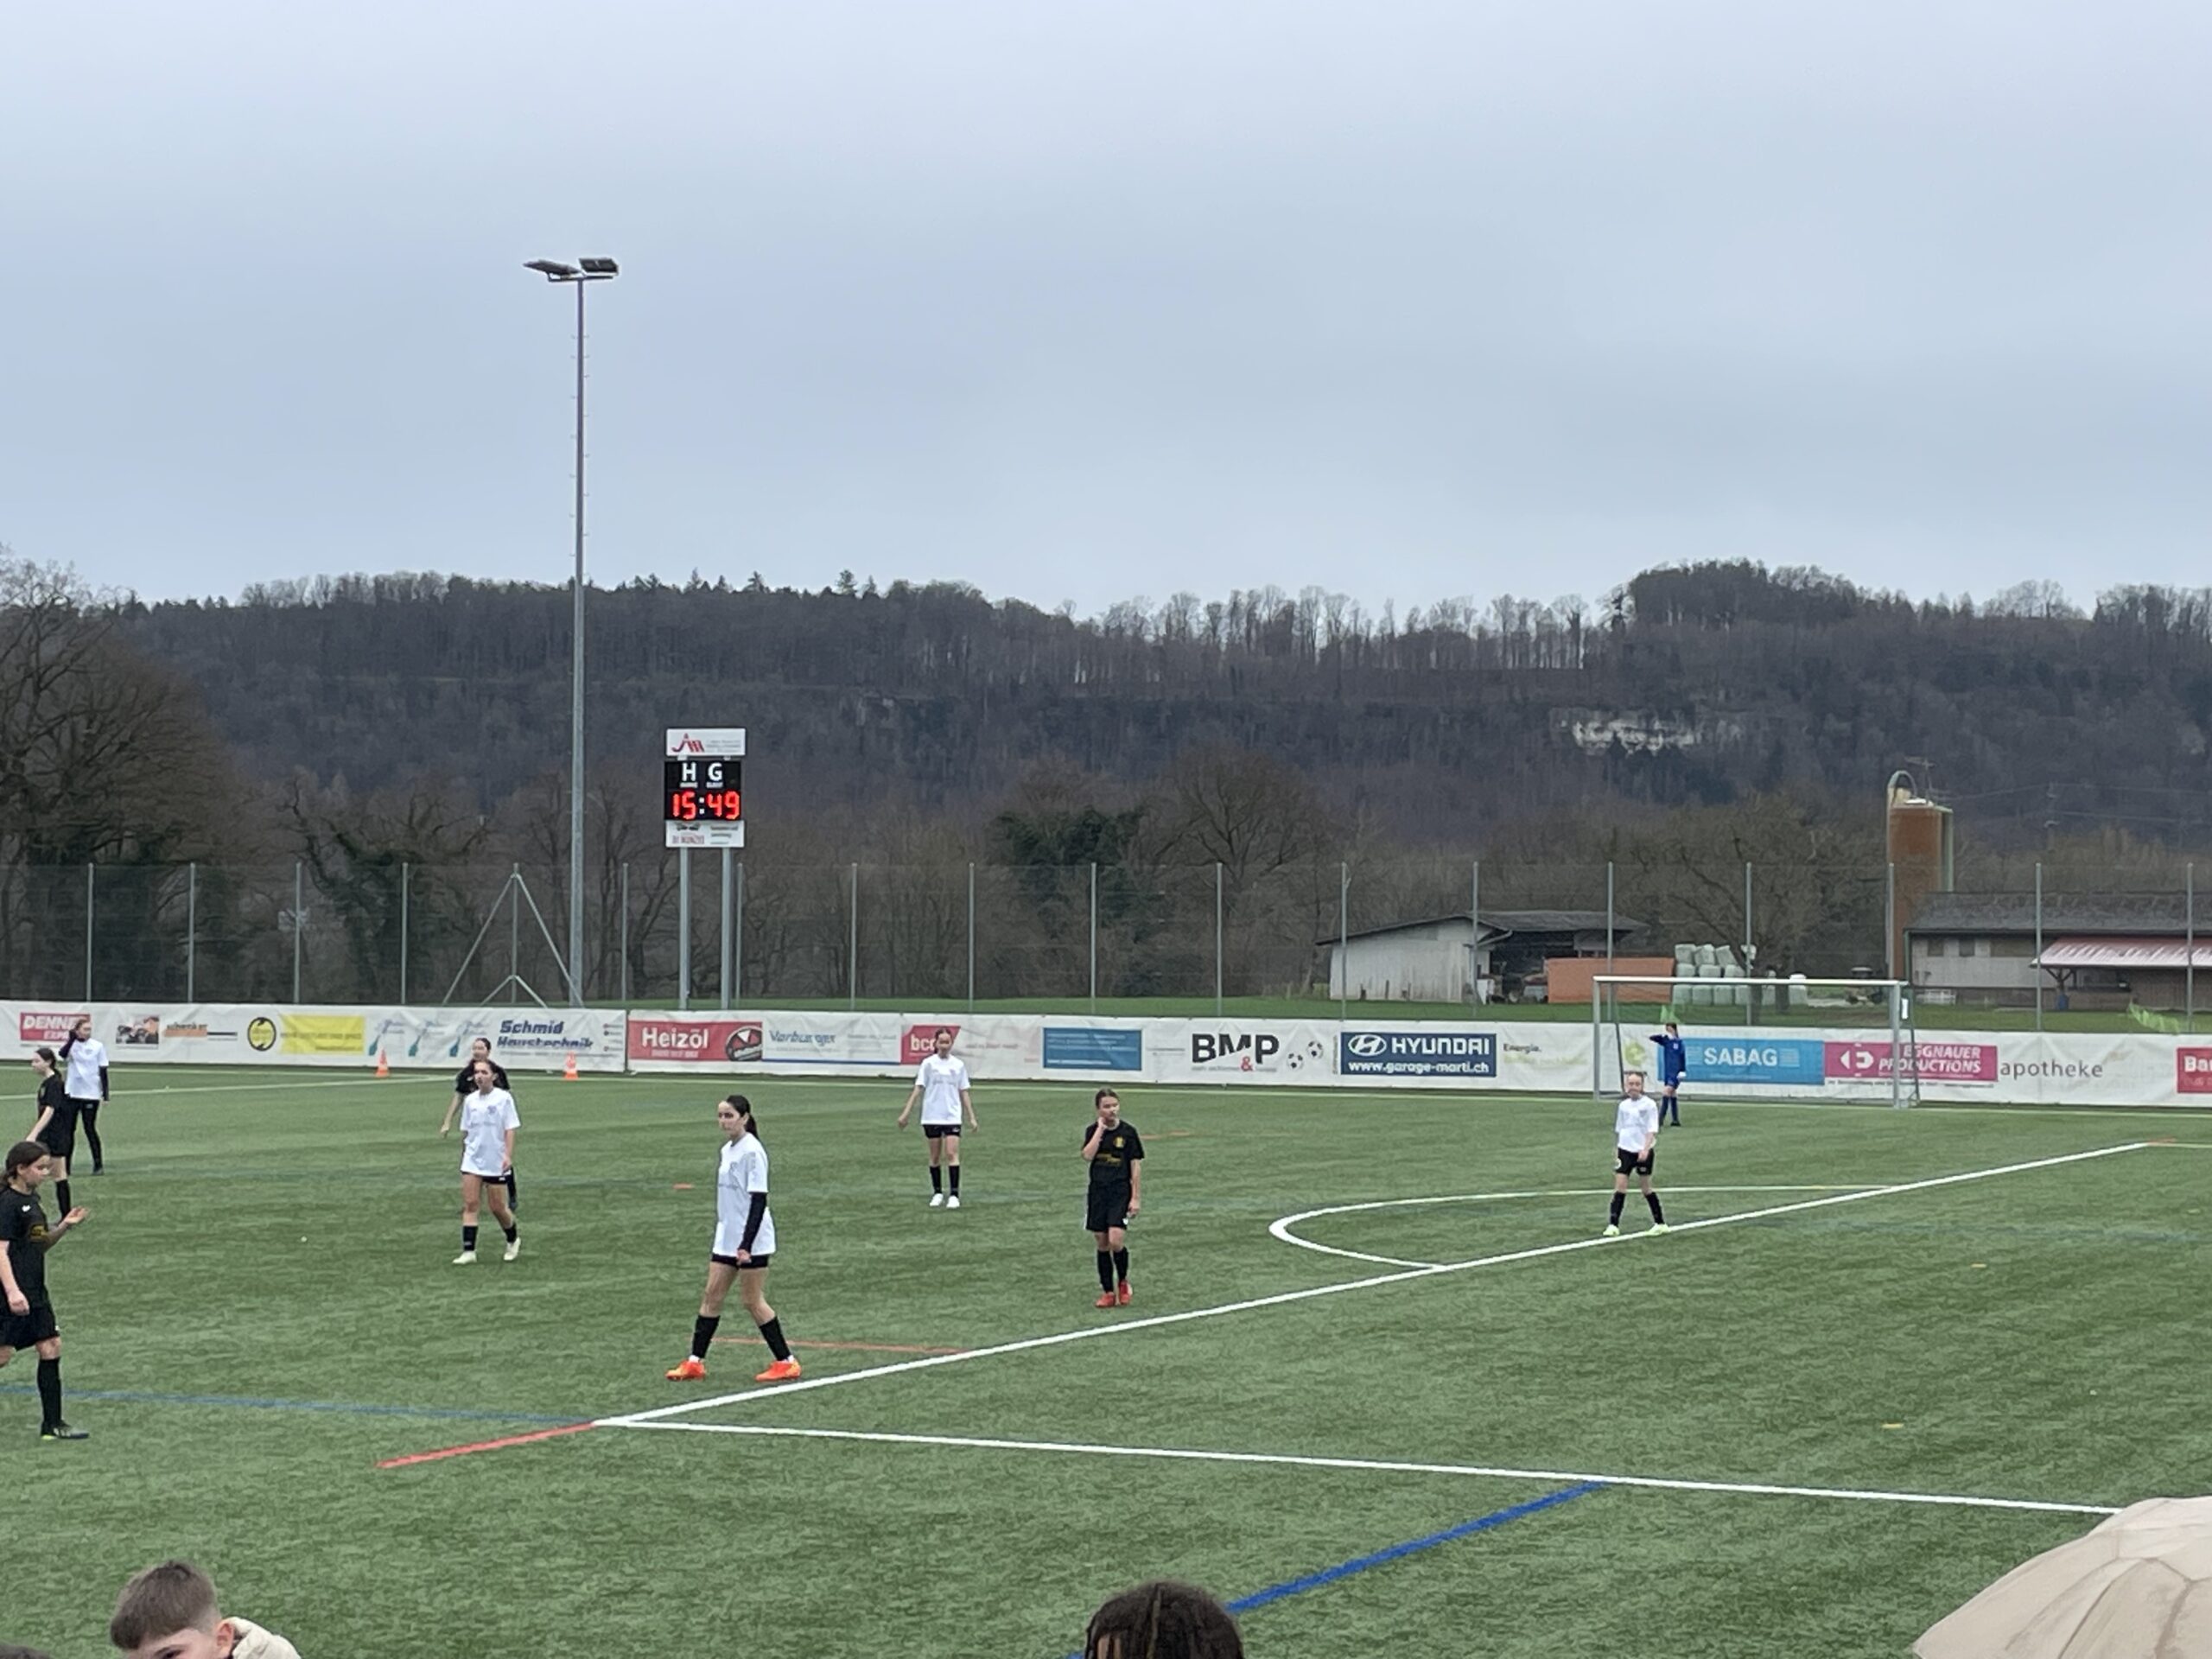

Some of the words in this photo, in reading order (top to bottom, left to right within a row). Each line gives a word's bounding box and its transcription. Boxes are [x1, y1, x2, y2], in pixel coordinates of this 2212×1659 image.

[682, 762, 696, 781] H
[708, 763, 723, 781] G
[672, 791, 740, 820] 15:49
[22, 1015, 89, 1030] DENNE
[499, 1020, 564, 1034] Schmid
[642, 1027, 709, 1049] Heizöl
[1391, 1037, 1490, 1055] HYUNDAI
[1704, 1047, 1777, 1066] SABAG
[2184, 1055, 2212, 1072] Ba
[1348, 1061, 1489, 1074] www.garage-marti.ch
[2000, 1059, 2103, 1079] apotheke
